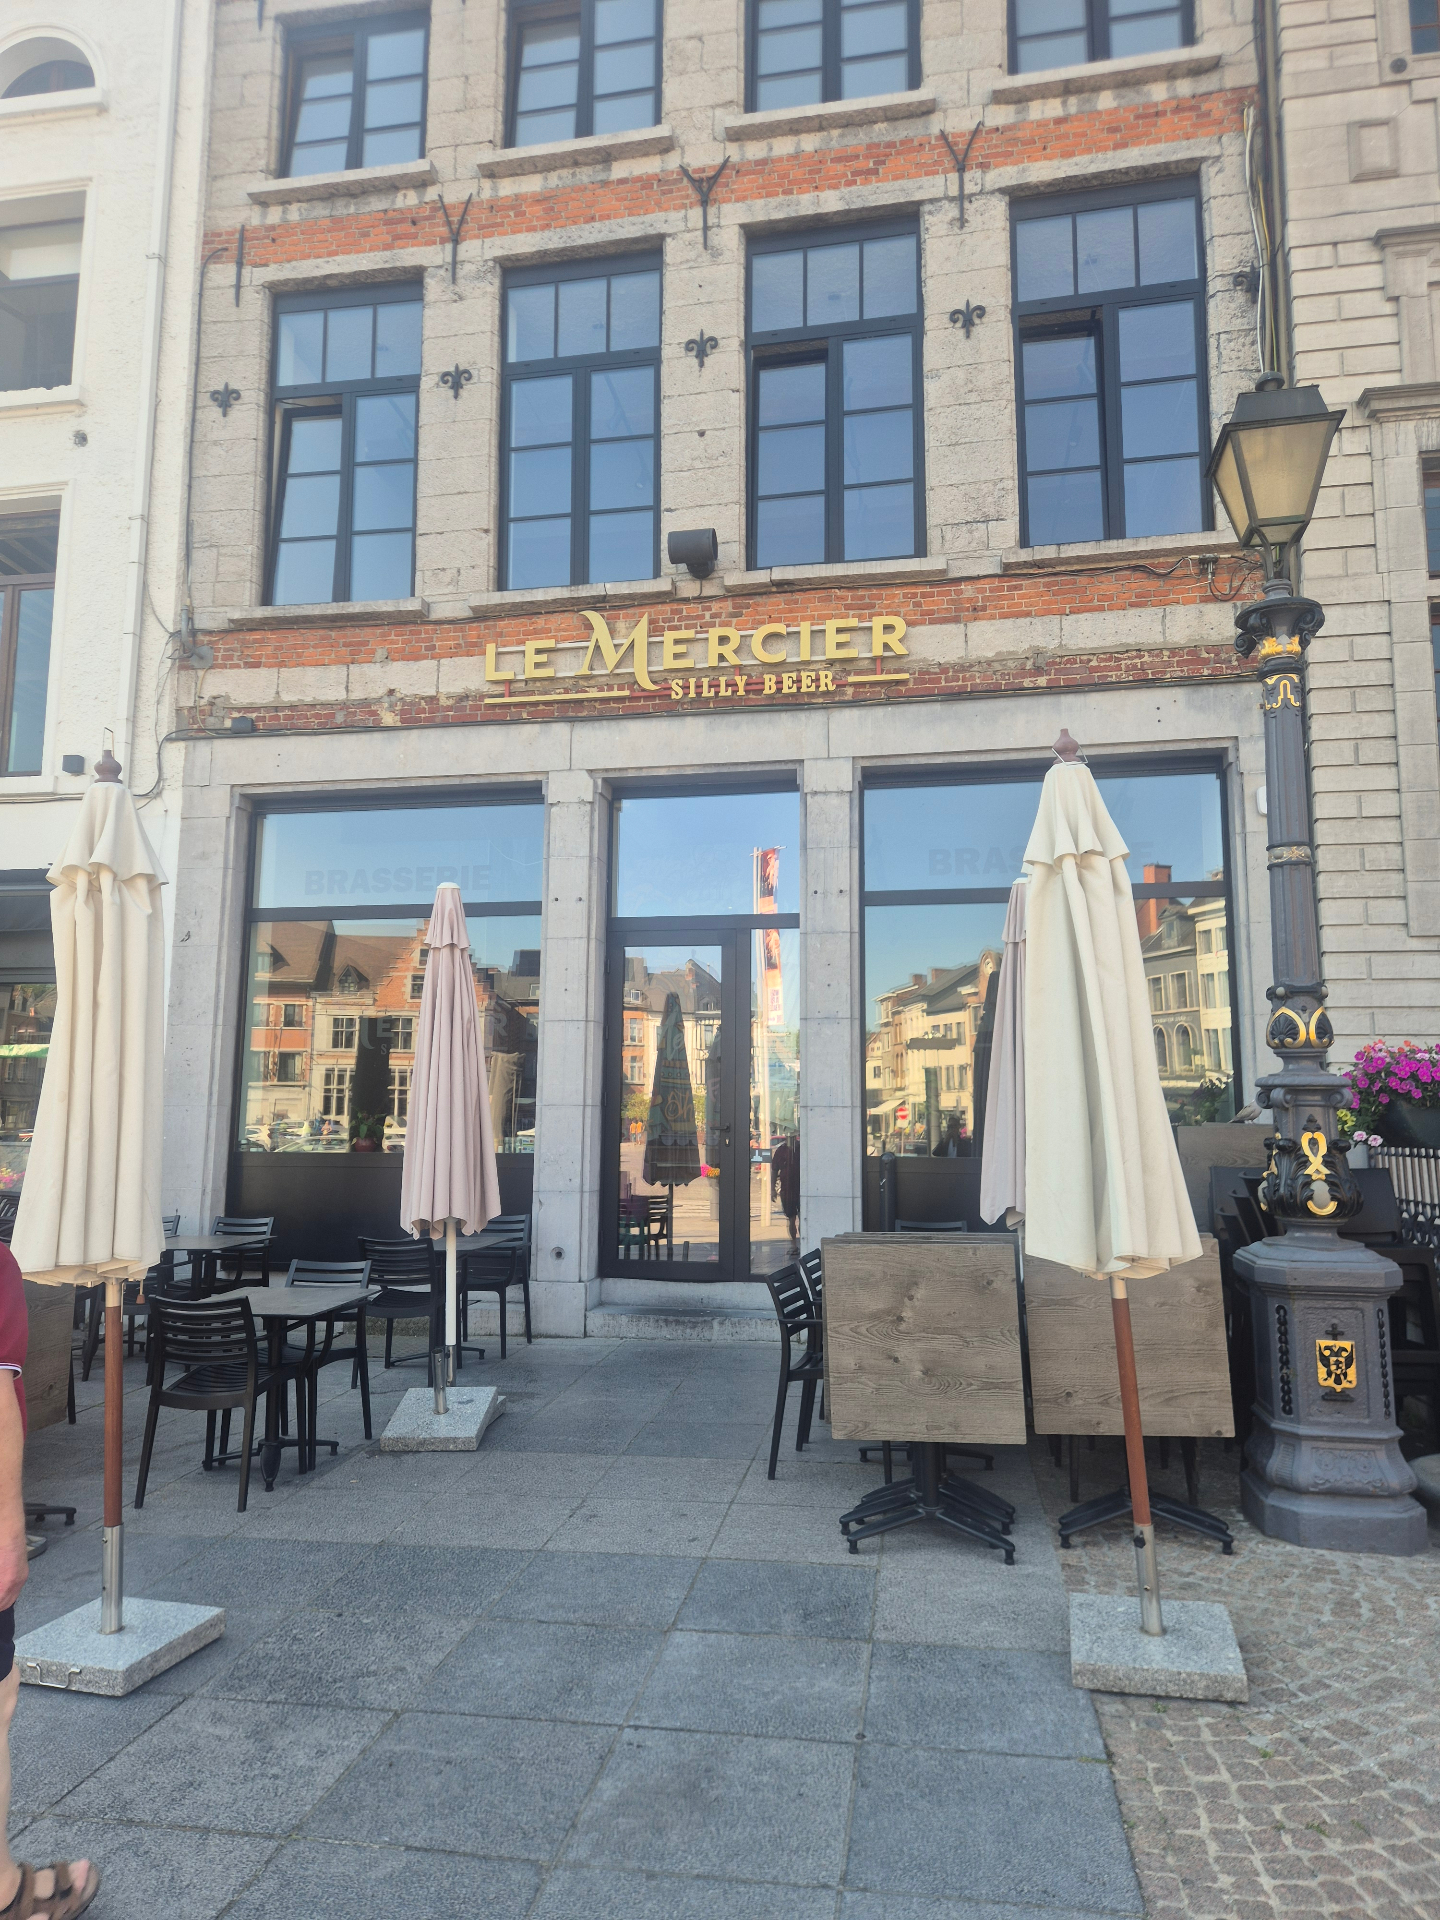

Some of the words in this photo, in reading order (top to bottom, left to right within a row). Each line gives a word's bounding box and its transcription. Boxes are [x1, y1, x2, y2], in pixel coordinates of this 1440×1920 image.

[485, 639, 555, 681] LE
[574, 610, 909, 691] MERCIER
[671, 675, 747, 700] SILLY
[763, 670, 836, 695] BEER
[304, 864, 492, 896] BRASSERIE
